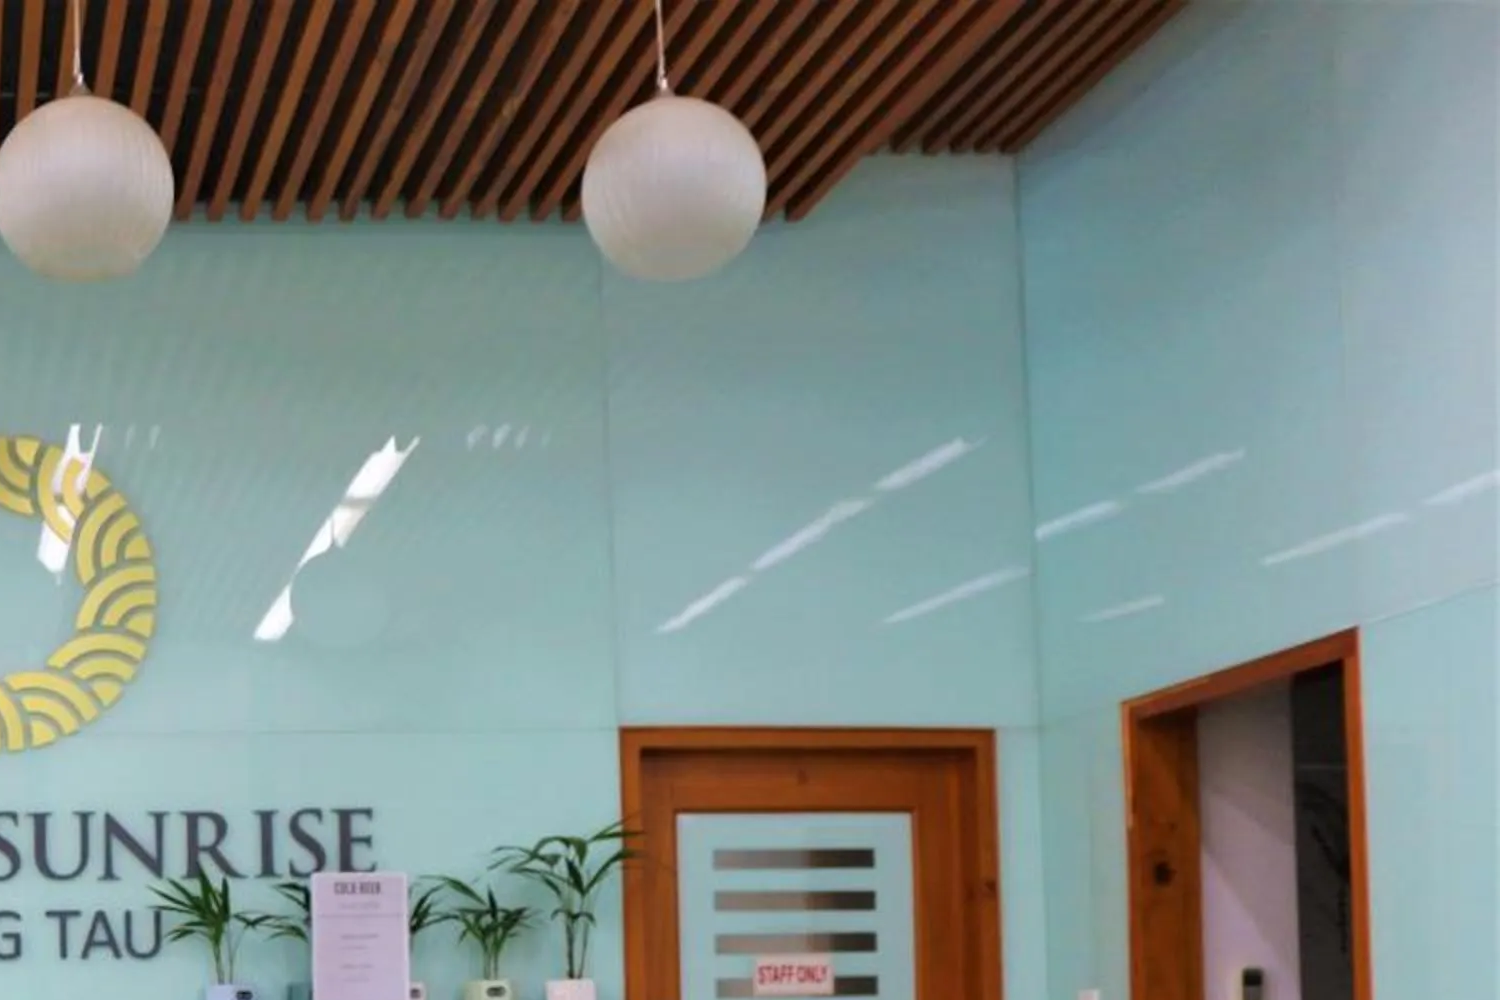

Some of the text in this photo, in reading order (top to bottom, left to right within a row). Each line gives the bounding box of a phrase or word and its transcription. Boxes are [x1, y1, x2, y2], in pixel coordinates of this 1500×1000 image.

[45, 909, 163, 961] TAU
[757, 964, 828, 984] STAFF ONLY
